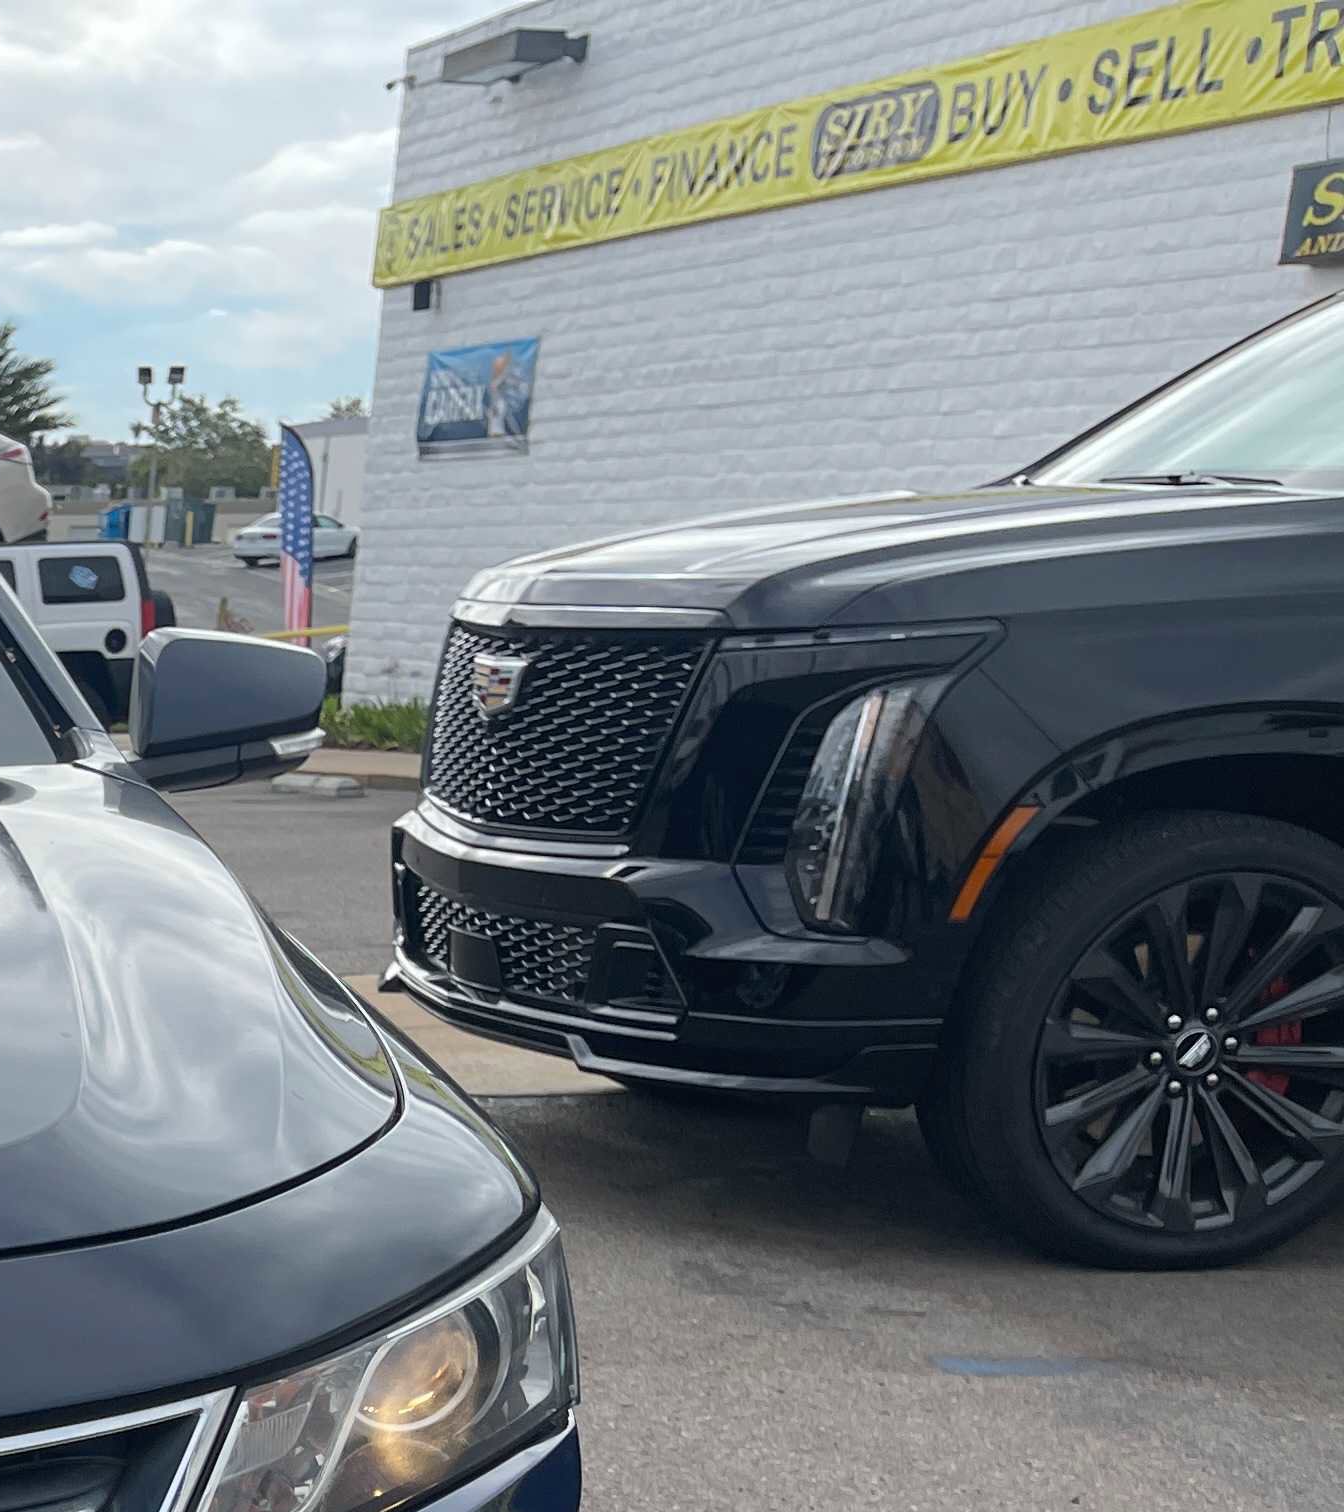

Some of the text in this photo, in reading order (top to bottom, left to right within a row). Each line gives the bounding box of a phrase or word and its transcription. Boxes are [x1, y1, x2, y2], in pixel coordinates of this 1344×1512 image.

[821, 88, 934, 152] SIRY
[946, 64, 1048, 144] BUY
[1086, 27, 1224, 116] SELL
[406, 124, 799, 259] SALES SERVICE FINANCE
